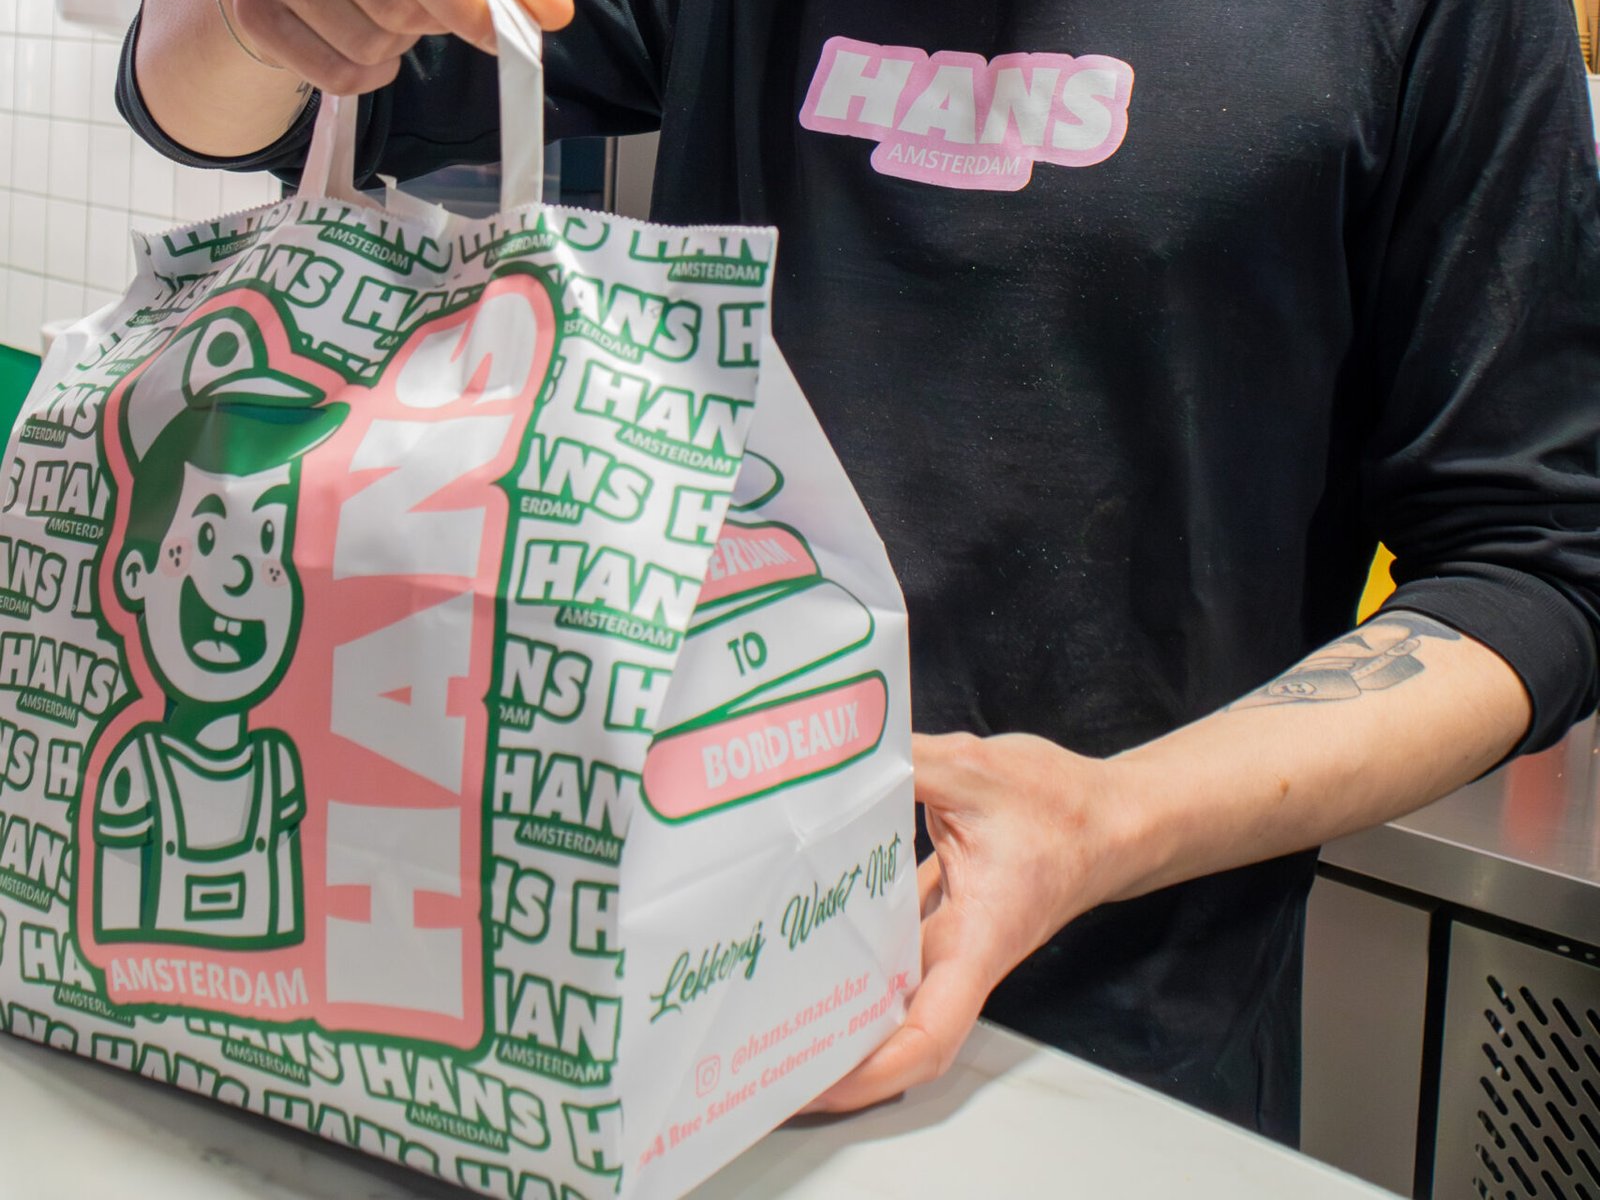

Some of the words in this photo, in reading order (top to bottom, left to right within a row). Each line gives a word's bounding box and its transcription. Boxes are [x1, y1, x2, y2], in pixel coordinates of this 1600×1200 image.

[814, 49, 1119, 151] HANS
[886, 143, 1021, 176] AMSTERDAM
[324, 226, 411, 270] AMSTERDAM
[671, 262, 761, 281] AMSTERDAM
[560, 270, 703, 364] ANS
[574, 358, 756, 460] HAN
[621, 427, 733, 474] AMSTERDAM
[520, 496, 580, 521] ERDAM
[515, 538, 703, 634] HAN
[707, 536, 798, 582] ERDAM
[560, 606, 674, 649] AMSTERDAM
[727, 631, 768, 677] TO
[0, 631, 120, 721] HANS
[325, 290, 539, 1022] HANS
[499, 635, 593, 724] NS
[20, 693, 77, 722] AMSTERDAM
[702, 702, 859, 789] BORDEAUX
[492, 747, 642, 841] HAN
[521, 822, 619, 860] AMSTERDAM
[781, 863, 863, 951] Wacht
[866, 832, 902, 899] Niet
[110, 956, 311, 1010] AMSTERDAM
[731, 971, 870, 1076] @hans.snackbar
[225, 1041, 307, 1083] AMSTERDAM
[500, 1042, 604, 1083] AMSTERDAM
[356, 1043, 552, 1152] HANS
[669, 1122, 703, 1150] Rue
[706, 1080, 757, 1128] Sainte
[758, 1031, 836, 1089] Catherine
[409, 1105, 505, 1149] AMSTERDAM
